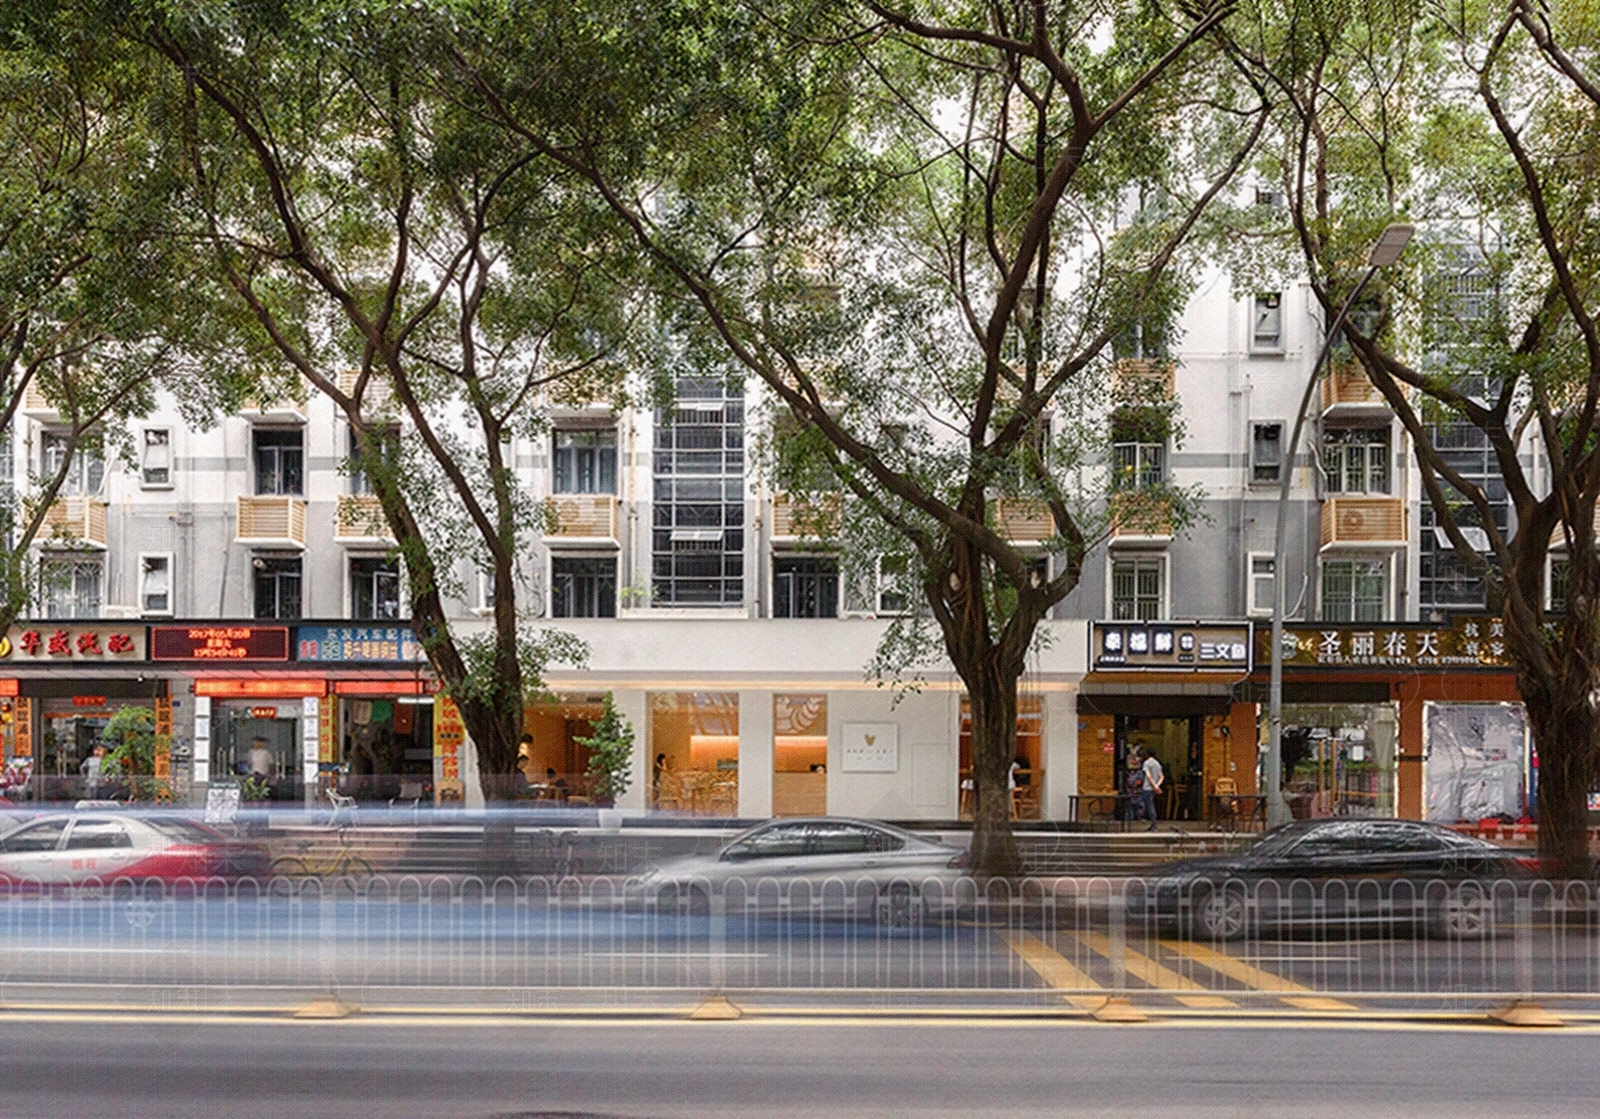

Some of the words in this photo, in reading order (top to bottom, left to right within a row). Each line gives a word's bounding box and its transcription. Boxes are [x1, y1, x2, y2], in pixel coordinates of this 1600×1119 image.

[19, 629, 134, 656] 华盛汽配
[1200, 642, 1246, 659] 三文鱼
[1318, 631, 1439, 656] 圣丽春天
